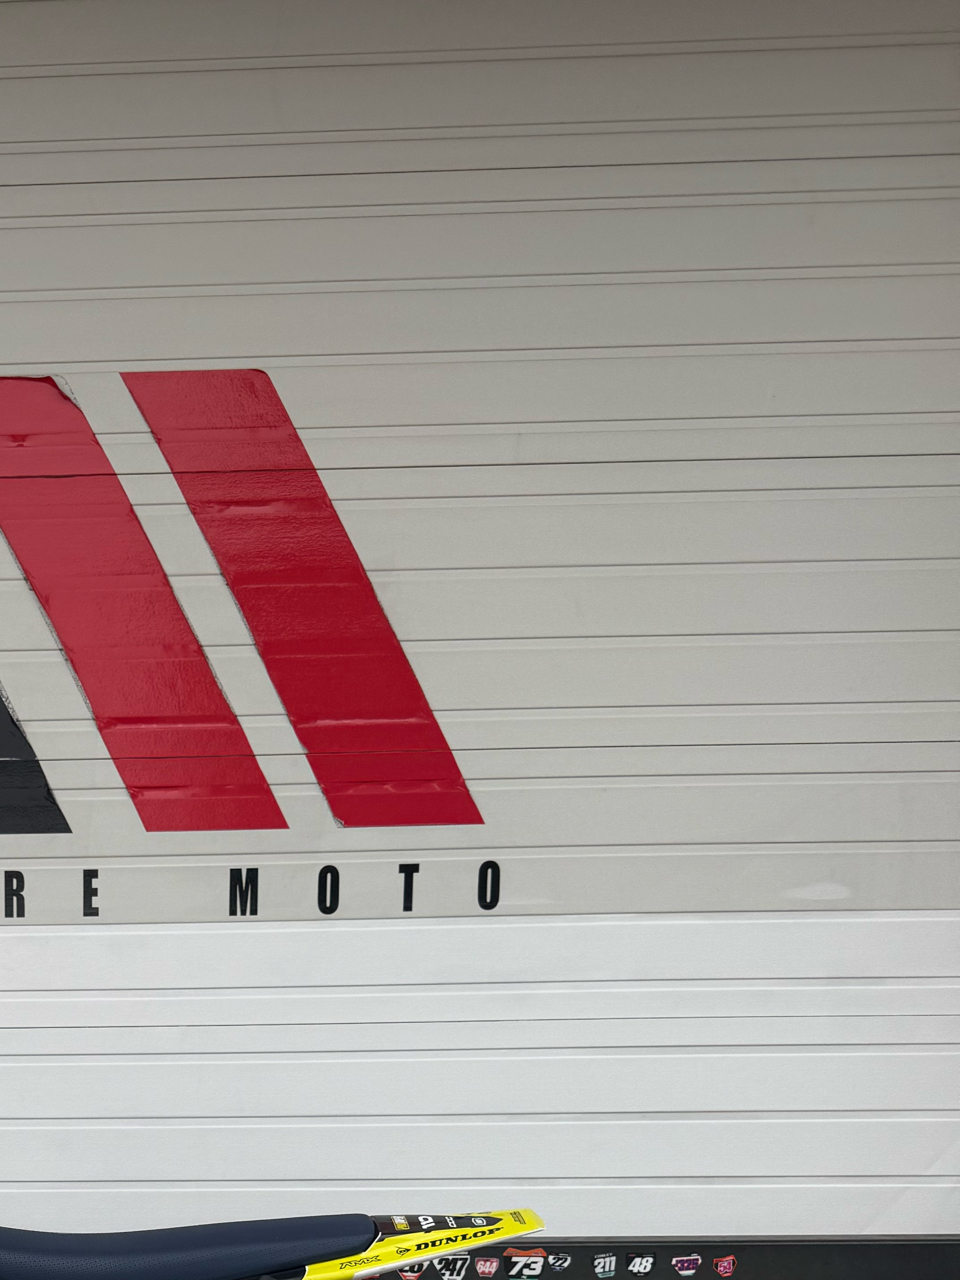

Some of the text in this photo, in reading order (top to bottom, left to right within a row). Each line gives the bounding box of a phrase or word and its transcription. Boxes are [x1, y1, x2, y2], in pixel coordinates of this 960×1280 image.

[229, 860, 500, 916] MOTO
[415, 1227, 503, 1251] DUNLOP
[437, 1257, 469, 1277] 247
[477, 1260, 497, 1273] 644
[508, 1256, 544, 1276] 73
[550, 1256, 568, 1268] 22
[594, 1256, 616, 1273] 211
[627, 1257, 654, 1273] 48
